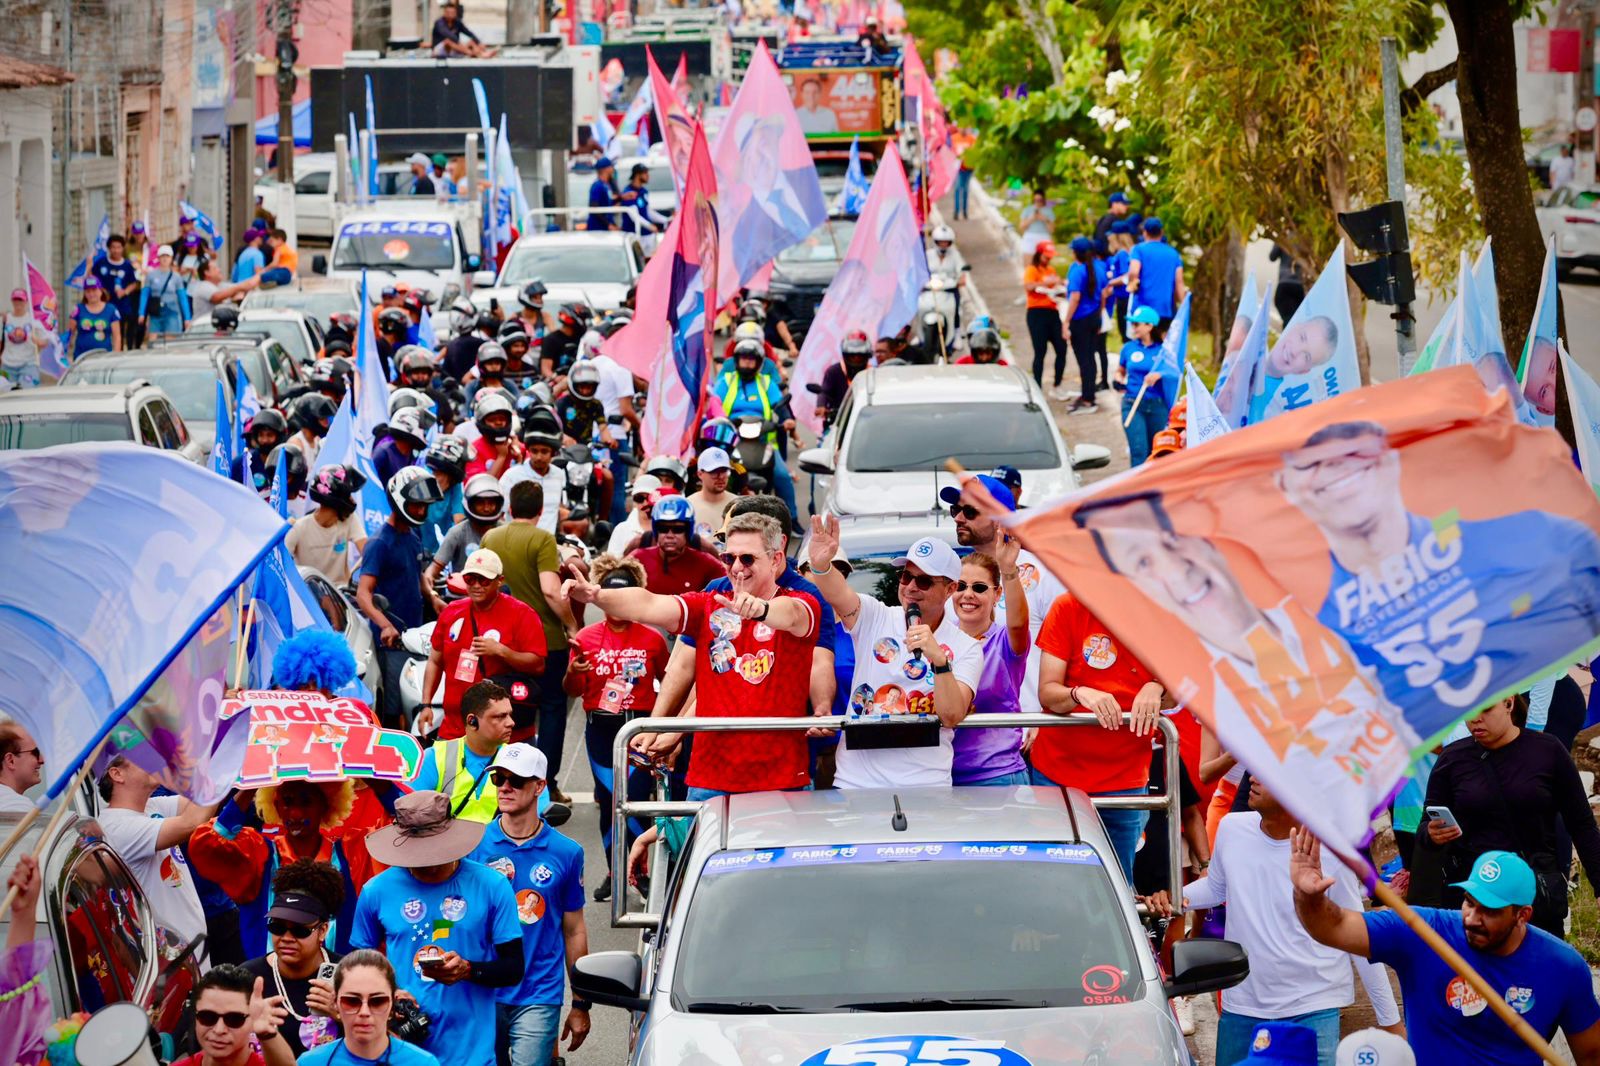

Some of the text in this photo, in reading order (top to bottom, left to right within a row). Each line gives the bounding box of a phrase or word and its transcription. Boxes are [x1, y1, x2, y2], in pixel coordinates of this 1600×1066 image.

[342, 222, 448, 236] 44.444
[918, 545, 931, 555] 55
[1372, 588, 1486, 688] 55
[742, 655, 770, 679] 131
[247, 692, 321, 702] SENADOR
[505, 750, 521, 758] 55
[840, 847, 858, 856] 55
[924, 845, 943, 854] 55
[1010, 845, 1028, 854] 55
[756, 852, 774, 860] 55
[535, 864, 553, 878] 55
[1482, 864, 1498, 878] 55
[404, 899, 421, 912] 55
[450, 899, 465, 909] 55
[1083, 995, 1129, 1006] OSPAL
[822, 1040, 1006, 1066] 55
[1357, 1052, 1375, 1065] 55
